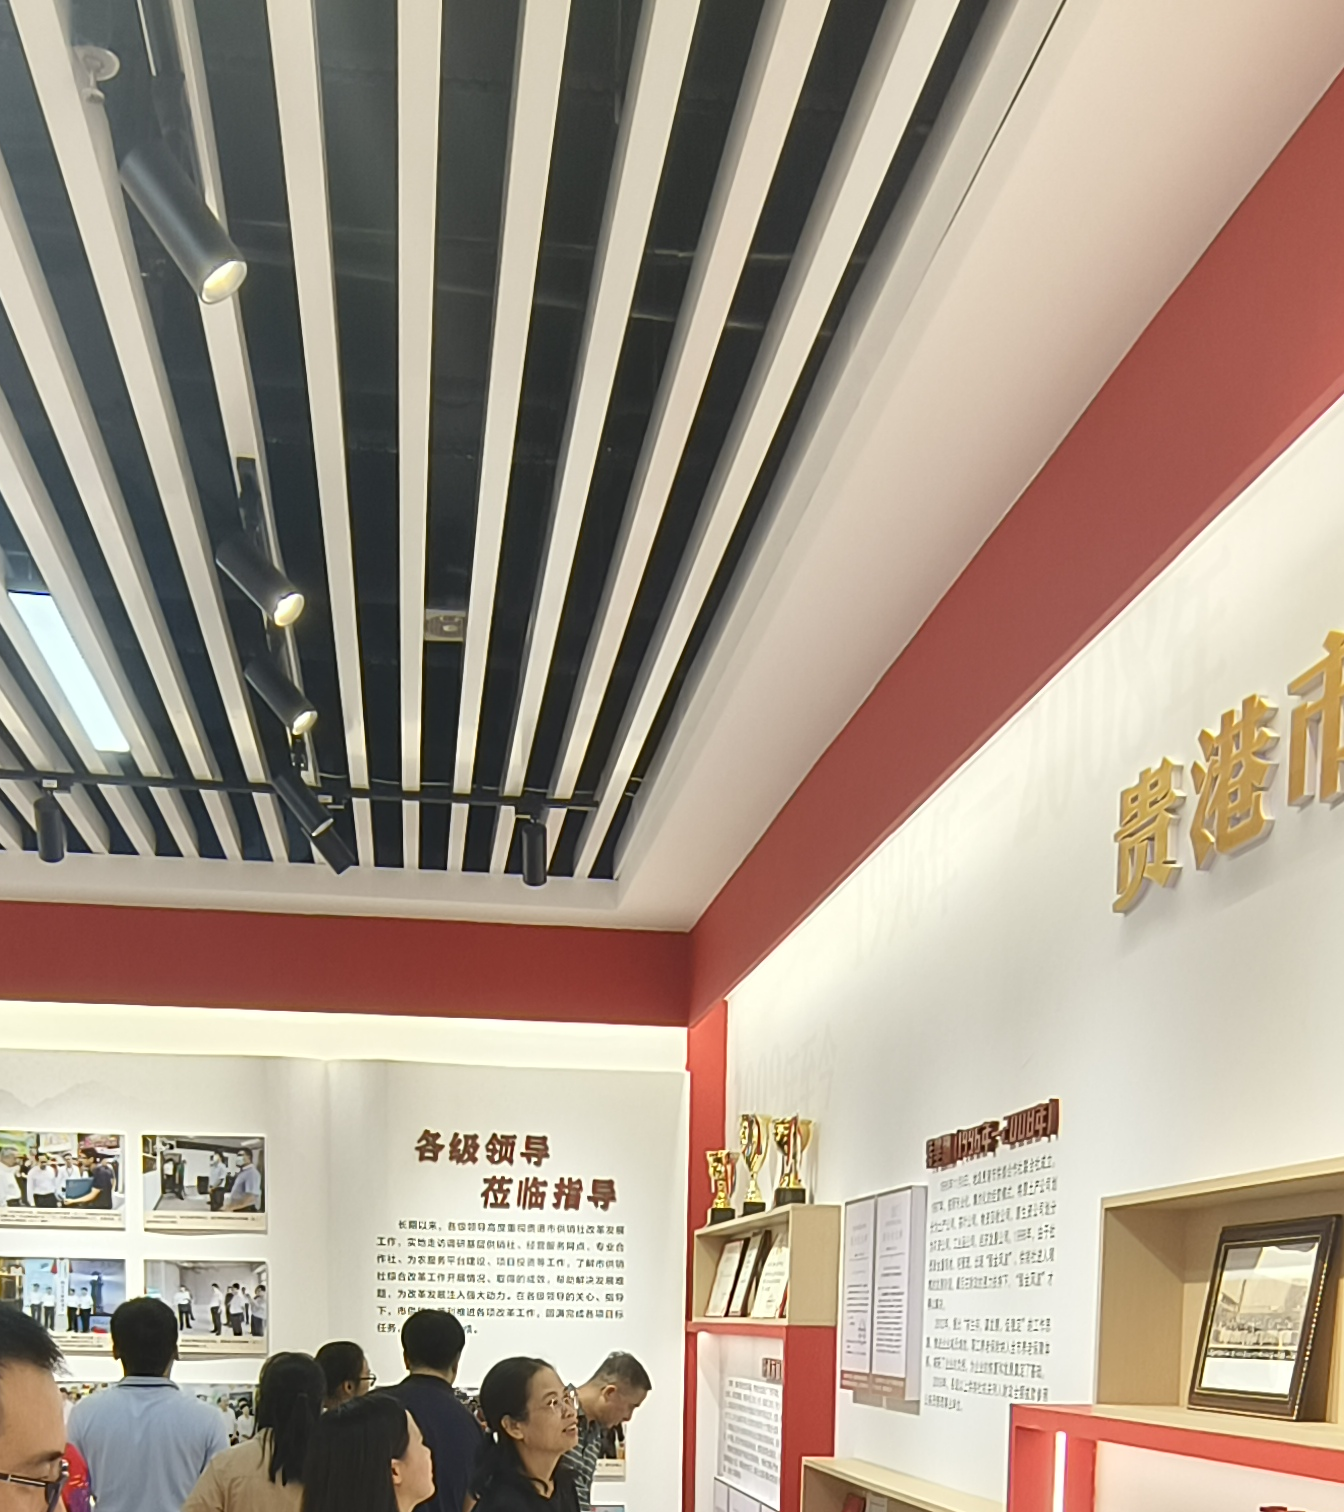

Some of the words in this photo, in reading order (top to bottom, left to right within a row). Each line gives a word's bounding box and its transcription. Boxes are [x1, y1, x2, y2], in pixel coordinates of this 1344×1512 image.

[415, 1129, 551, 1167] 各级领导
[480, 1175, 618, 1211] 莅临指导
